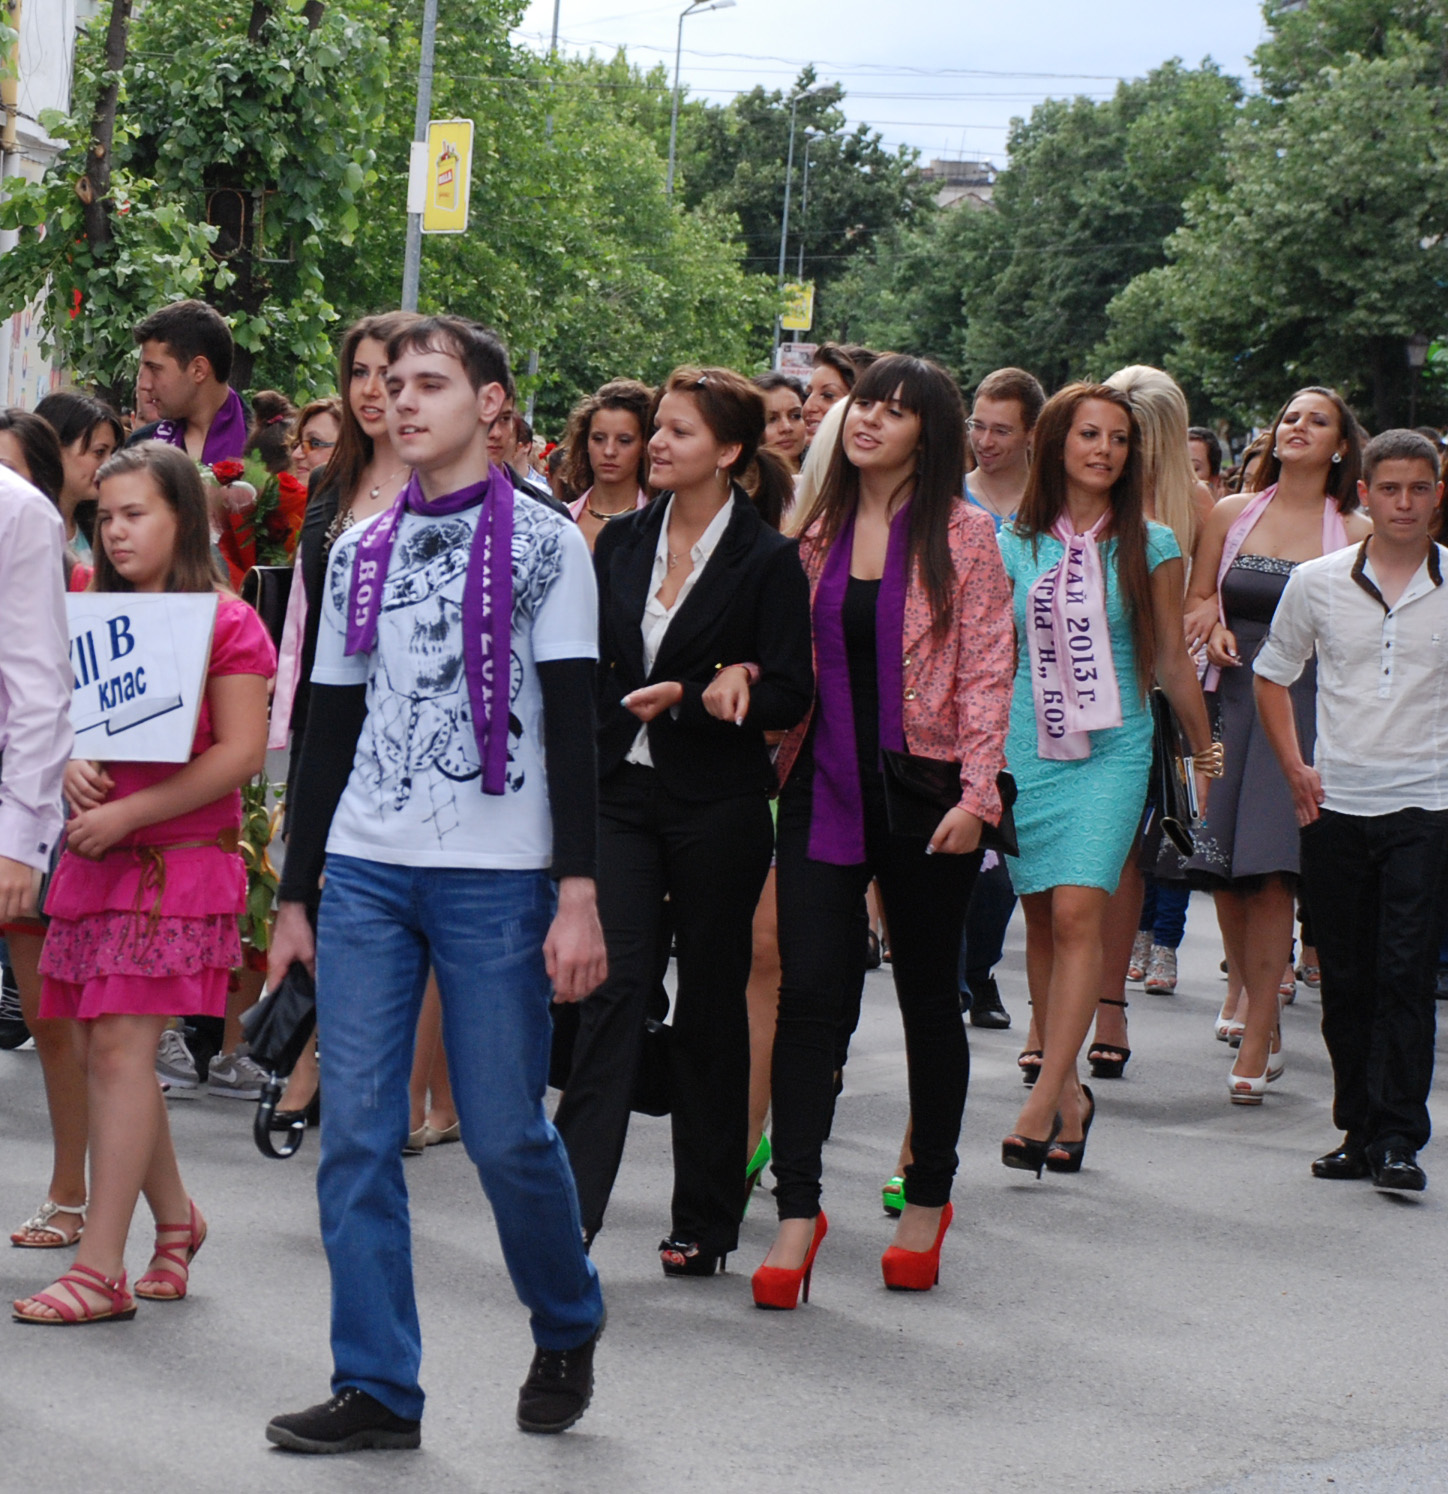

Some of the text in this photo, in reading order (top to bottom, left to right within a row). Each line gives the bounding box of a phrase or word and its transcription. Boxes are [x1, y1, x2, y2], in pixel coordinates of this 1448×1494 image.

[355, 559, 378, 627] СОУ
[106, 615, 135, 661] В
[1066, 617, 1098, 682] 2013
[98, 666, 147, 712] клас
[1043, 689, 1065, 740] СОУ
